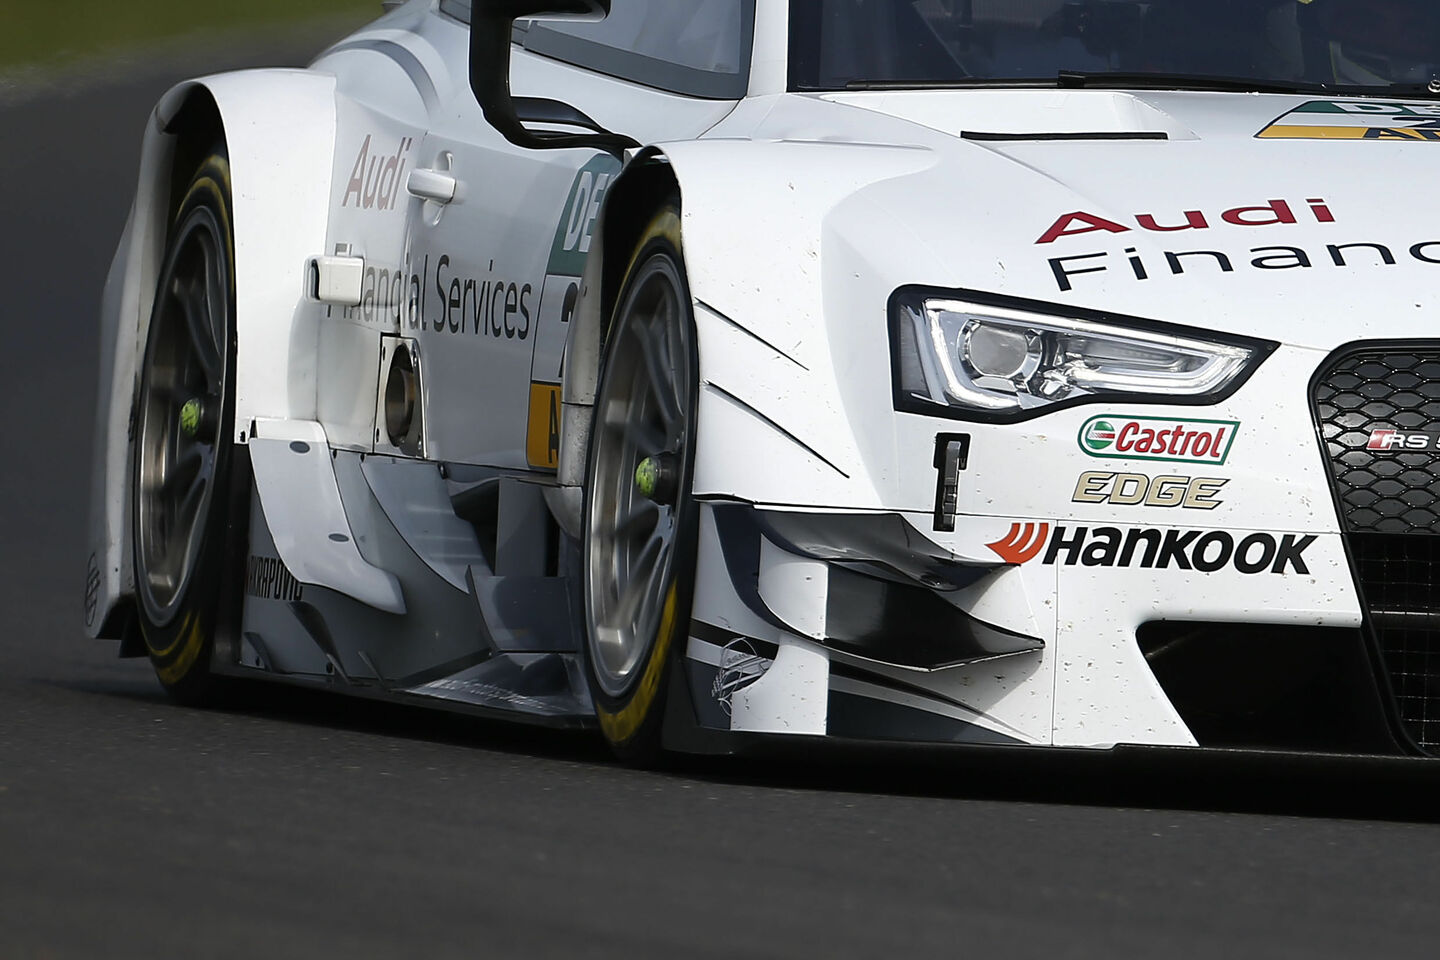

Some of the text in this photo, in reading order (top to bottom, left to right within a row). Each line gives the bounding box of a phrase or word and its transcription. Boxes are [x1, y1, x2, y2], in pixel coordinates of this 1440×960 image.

[342, 134, 412, 211] Audi
[1034, 198, 1336, 244] Audi
[433, 254, 532, 340] Services
[1115, 421, 1226, 458] Castrol
[1380, 433, 1430, 449] RS
[1072, 471, 1230, 510] EDGE
